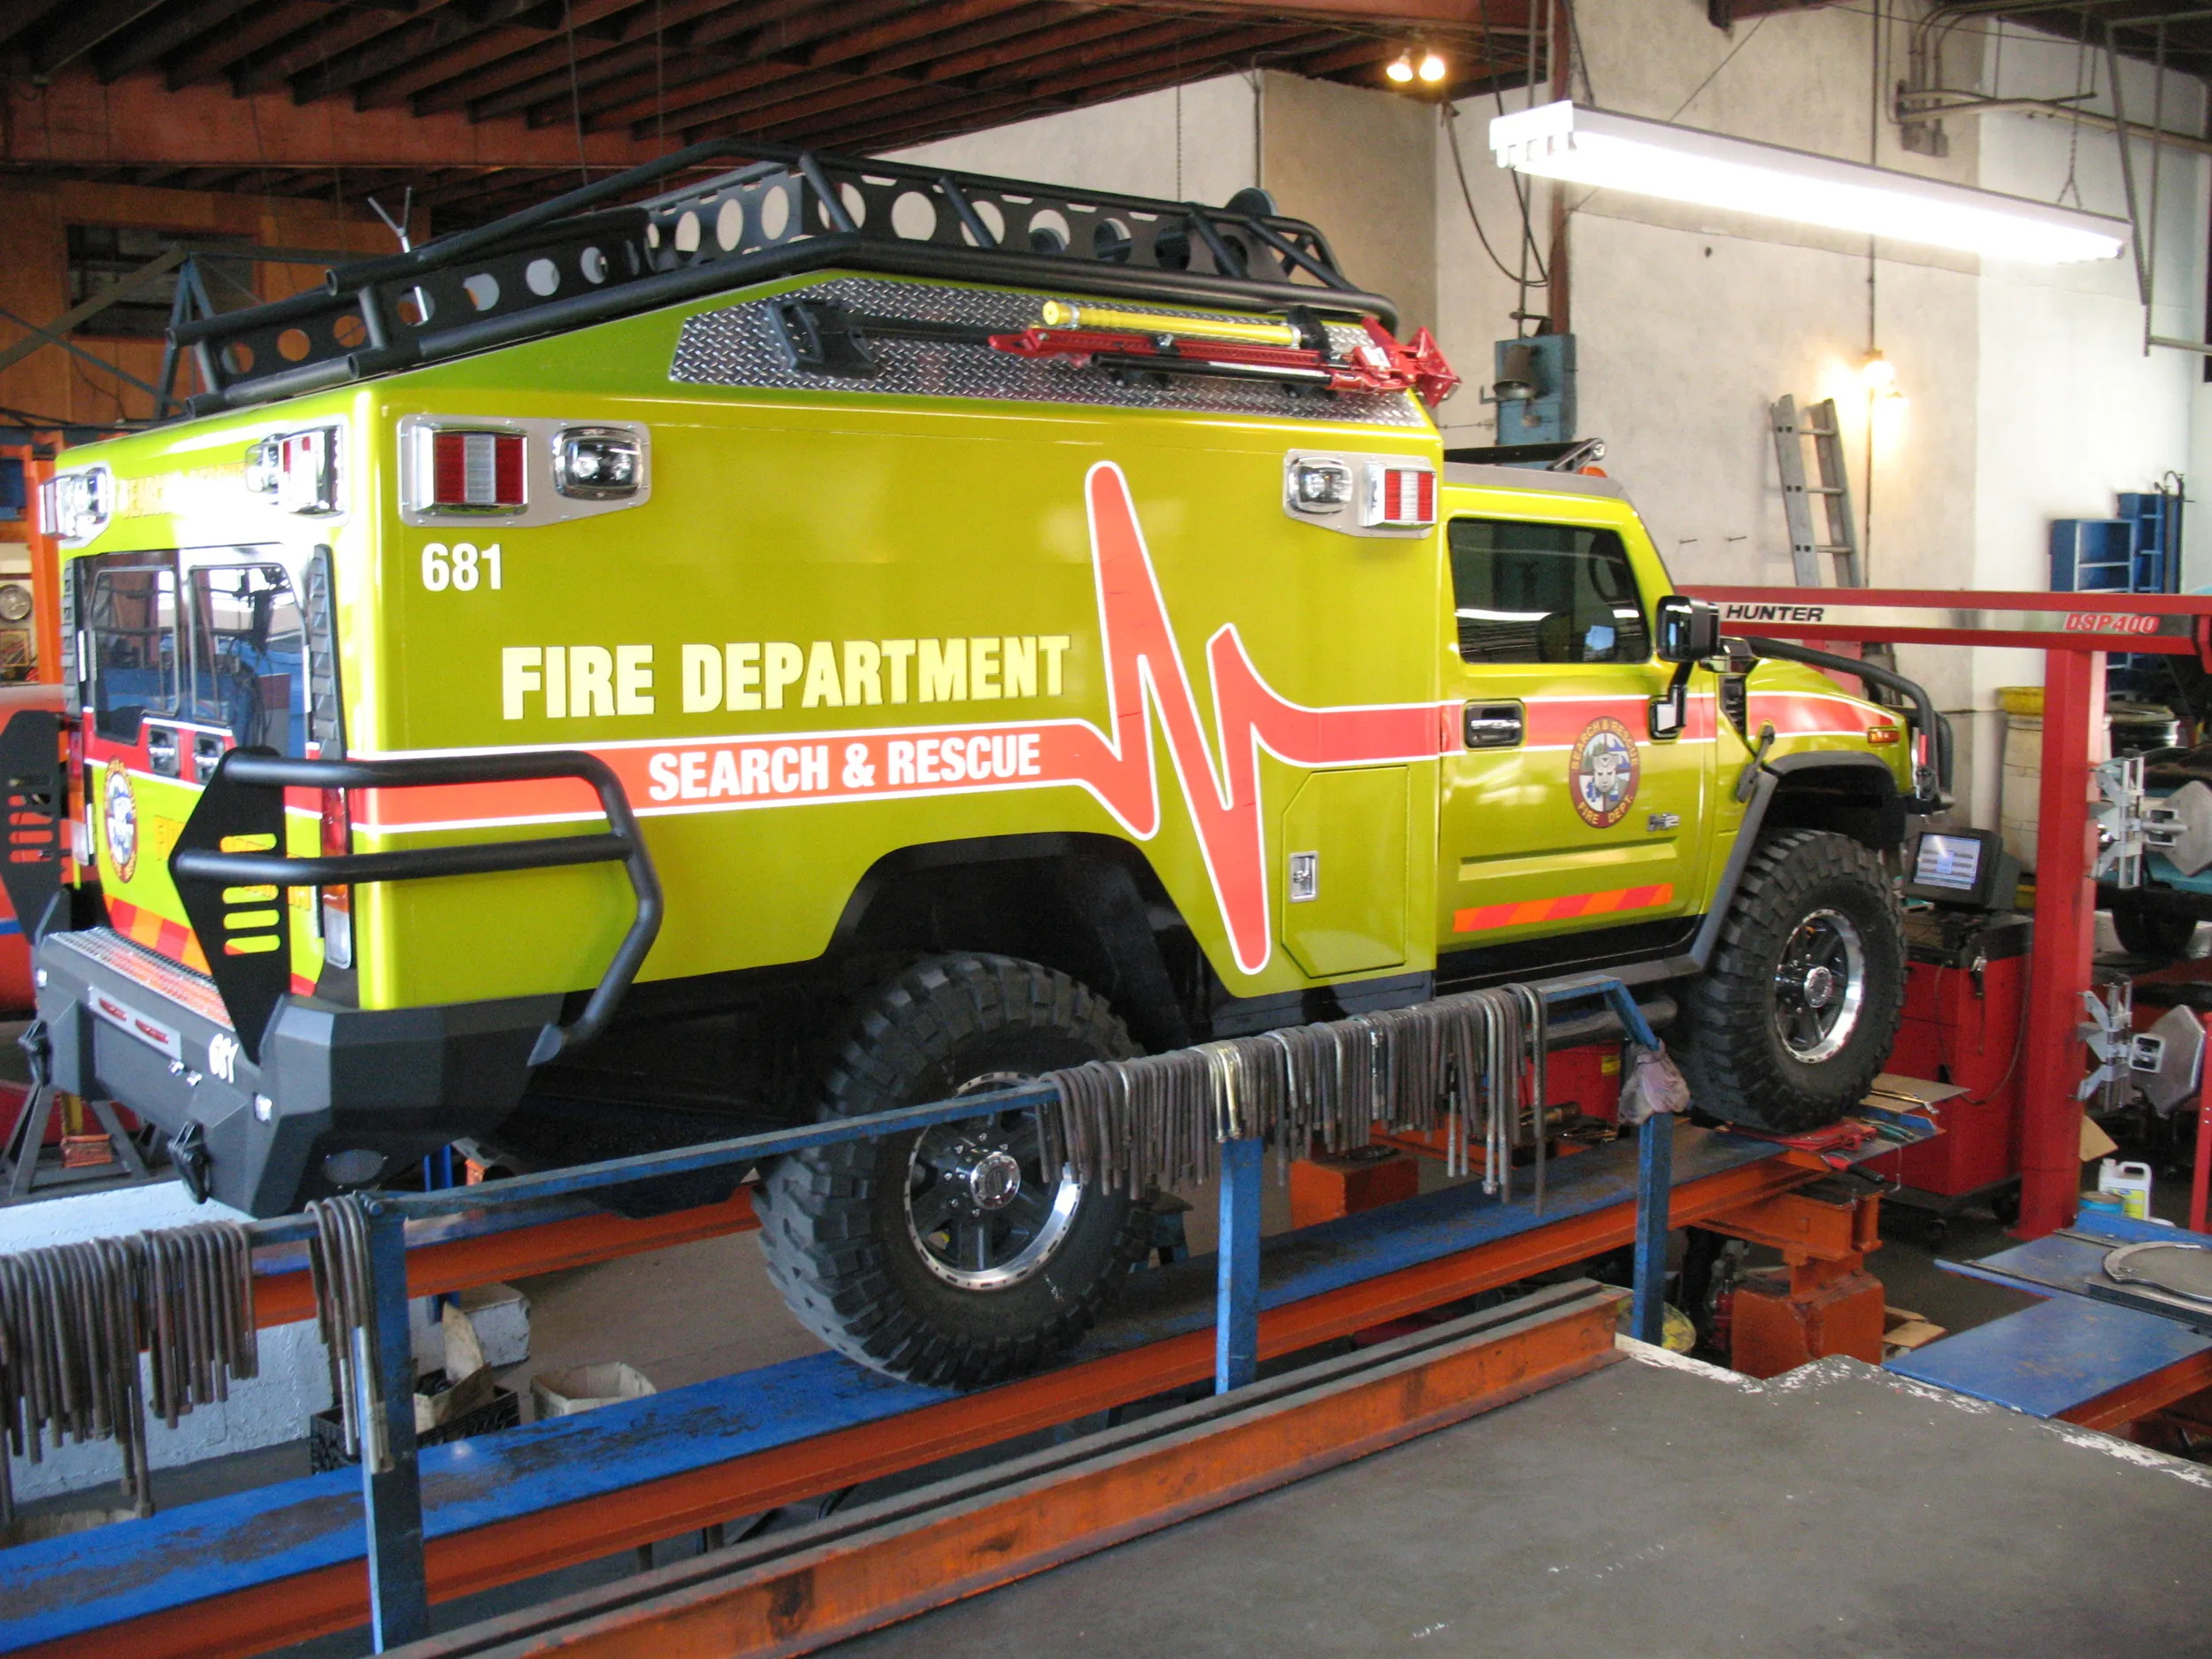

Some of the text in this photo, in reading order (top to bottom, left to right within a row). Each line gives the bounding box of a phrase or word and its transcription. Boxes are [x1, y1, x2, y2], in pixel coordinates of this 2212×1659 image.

[421, 542, 503, 592] 681
[1726, 604, 1824, 622] HUNTER
[2063, 613, 2161, 634] DSP400
[502, 635, 1071, 720] FIRE DEPARTMENT
[649, 733, 1041, 802] SEARCH & RESCUE
[1571, 720, 1601, 770] SEARCH
[1578, 801, 1601, 825] FIRE
